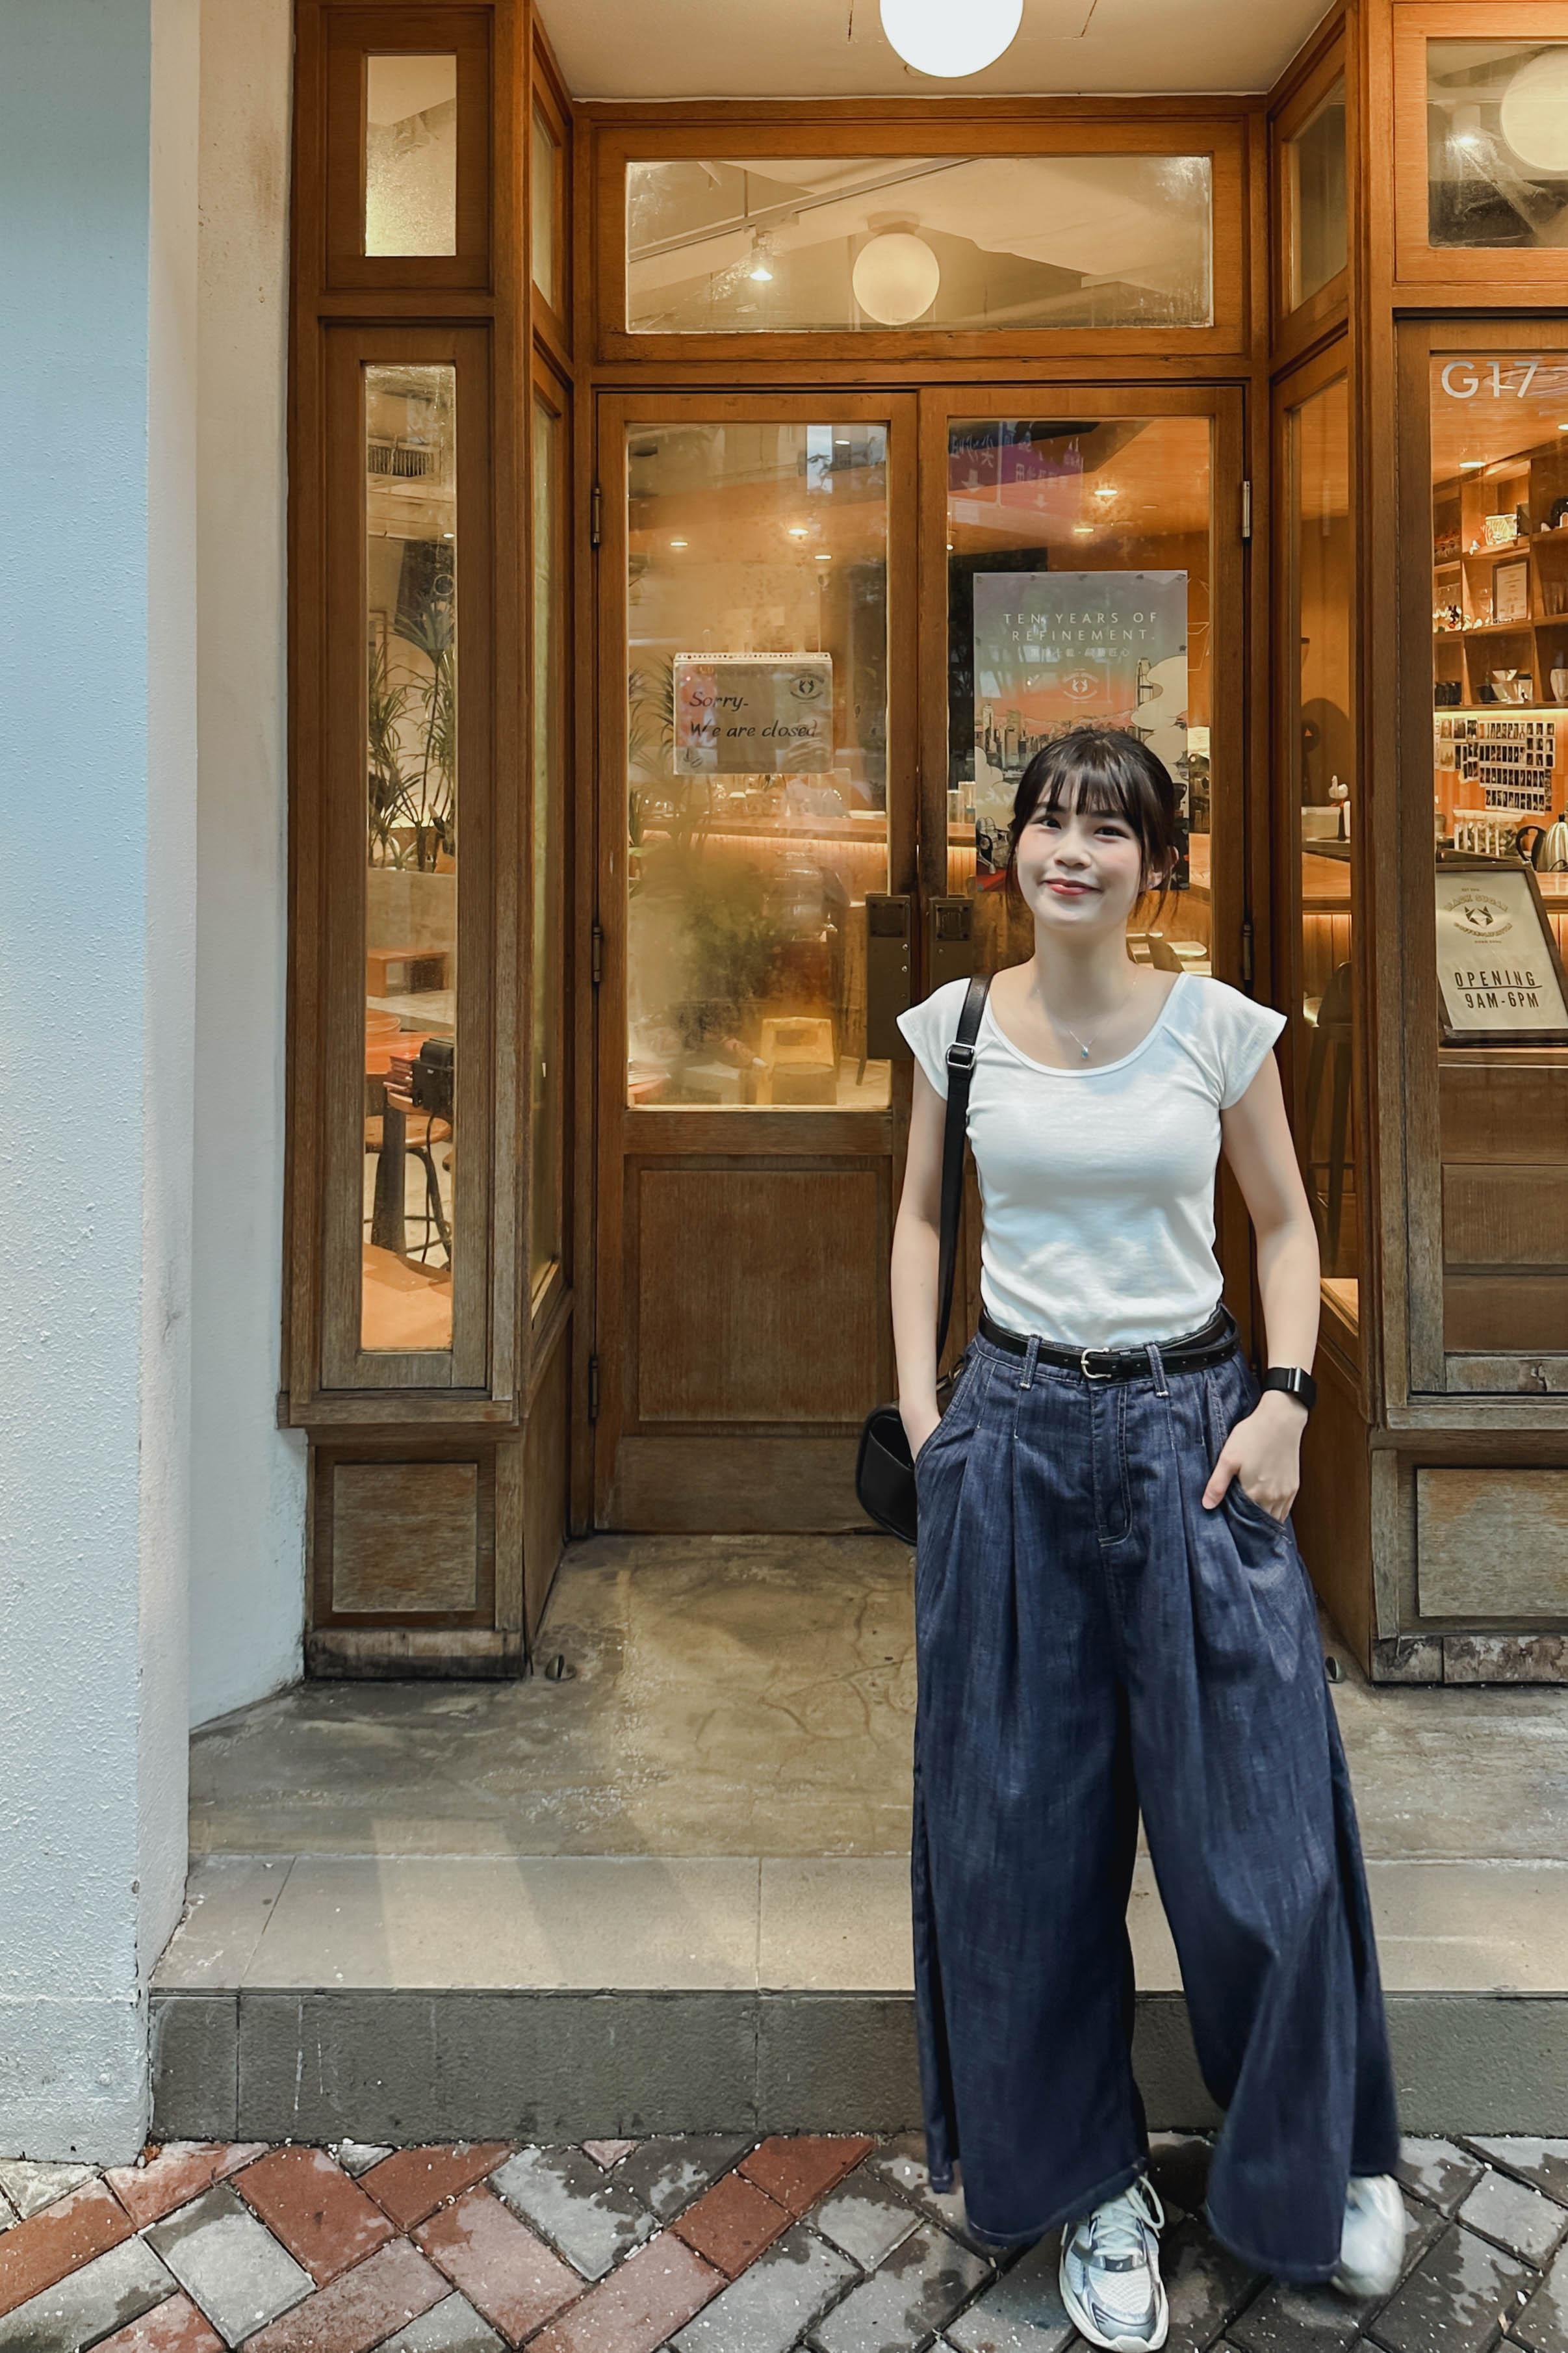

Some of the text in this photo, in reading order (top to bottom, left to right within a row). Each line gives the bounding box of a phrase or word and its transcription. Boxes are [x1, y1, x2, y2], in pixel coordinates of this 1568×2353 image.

[1441, 361, 1539, 398] G17
[1003, 612, 1157, 625] TEN YEARS OF
[1012, 629, 1155, 642] REFINEMENT.
[690, 718, 817, 738] We are closed
[1454, 970, 1536, 987] OPENING
[1465, 992, 1539, 1008] 9AM-6PM
